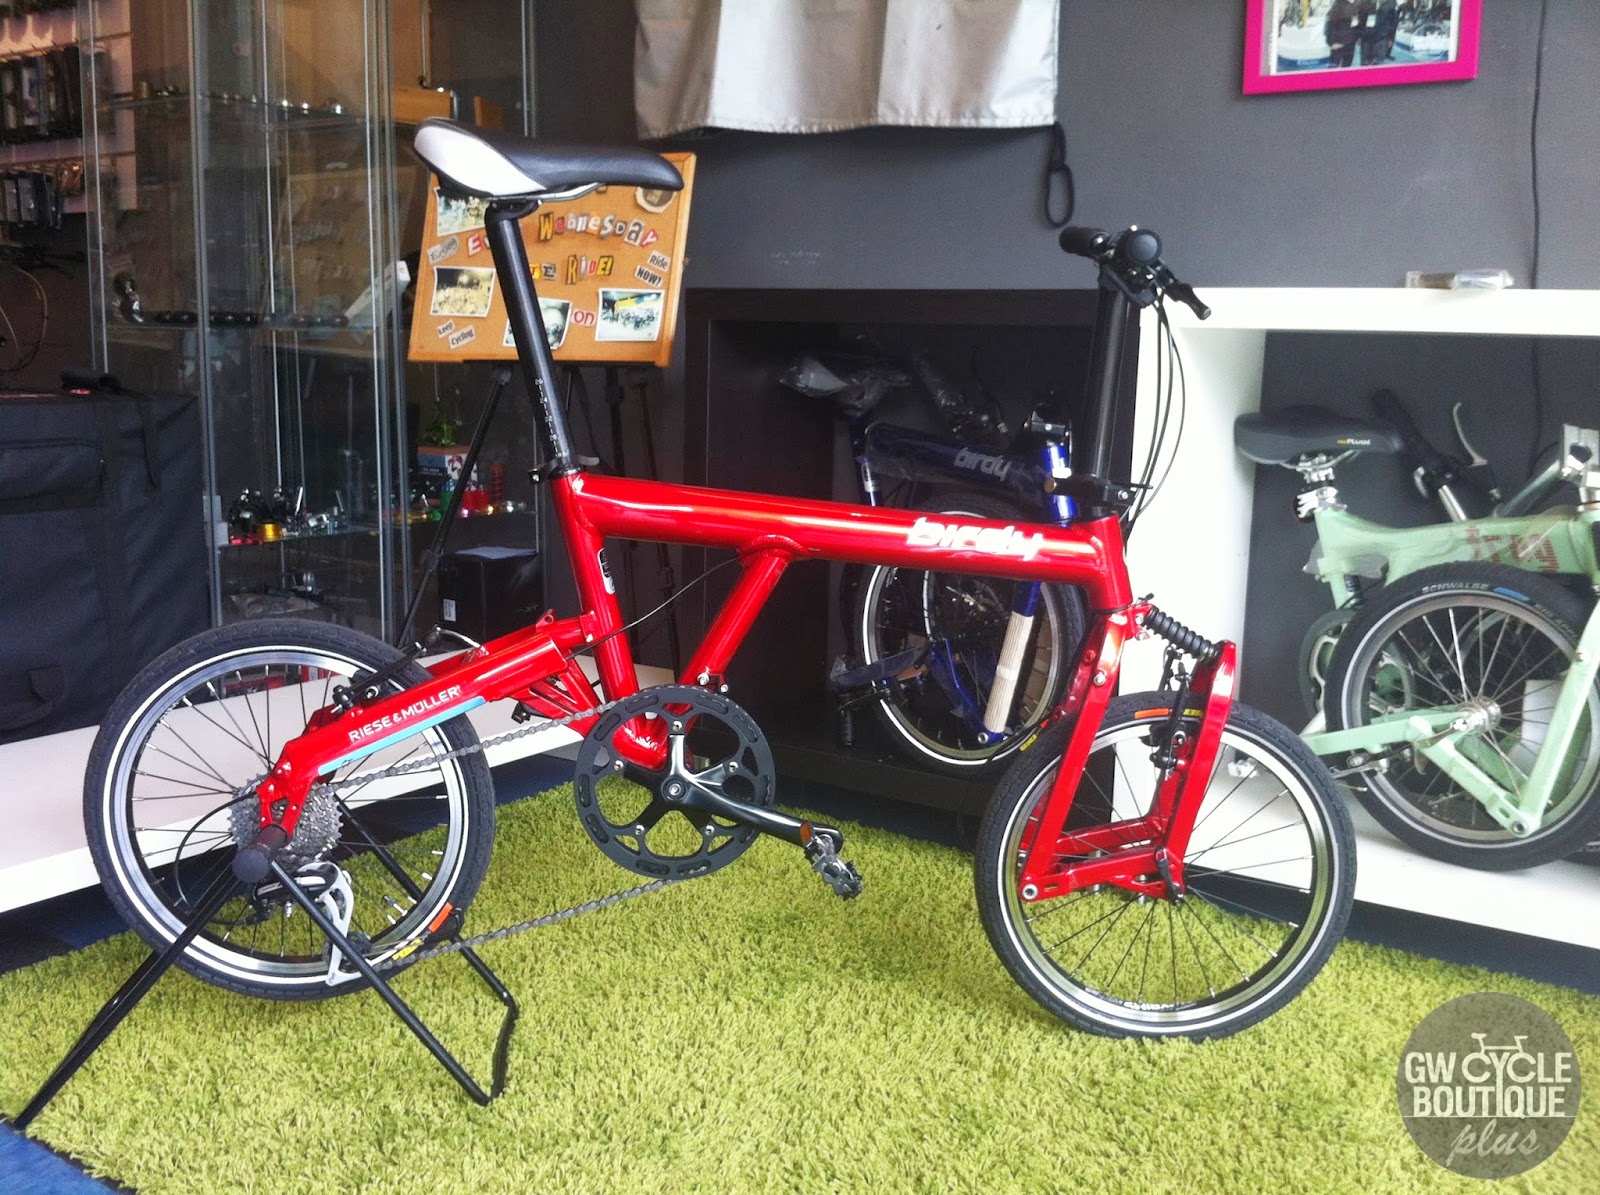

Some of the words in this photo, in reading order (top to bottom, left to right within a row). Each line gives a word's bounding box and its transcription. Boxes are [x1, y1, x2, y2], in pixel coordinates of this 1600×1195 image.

[953, 446, 1013, 482] birdy
[906, 516, 1045, 561] birdy
[1421, 581, 1490, 595] SCHWALBE
[347, 717, 394, 743] RIESE
[392, 711, 403, 723] &
